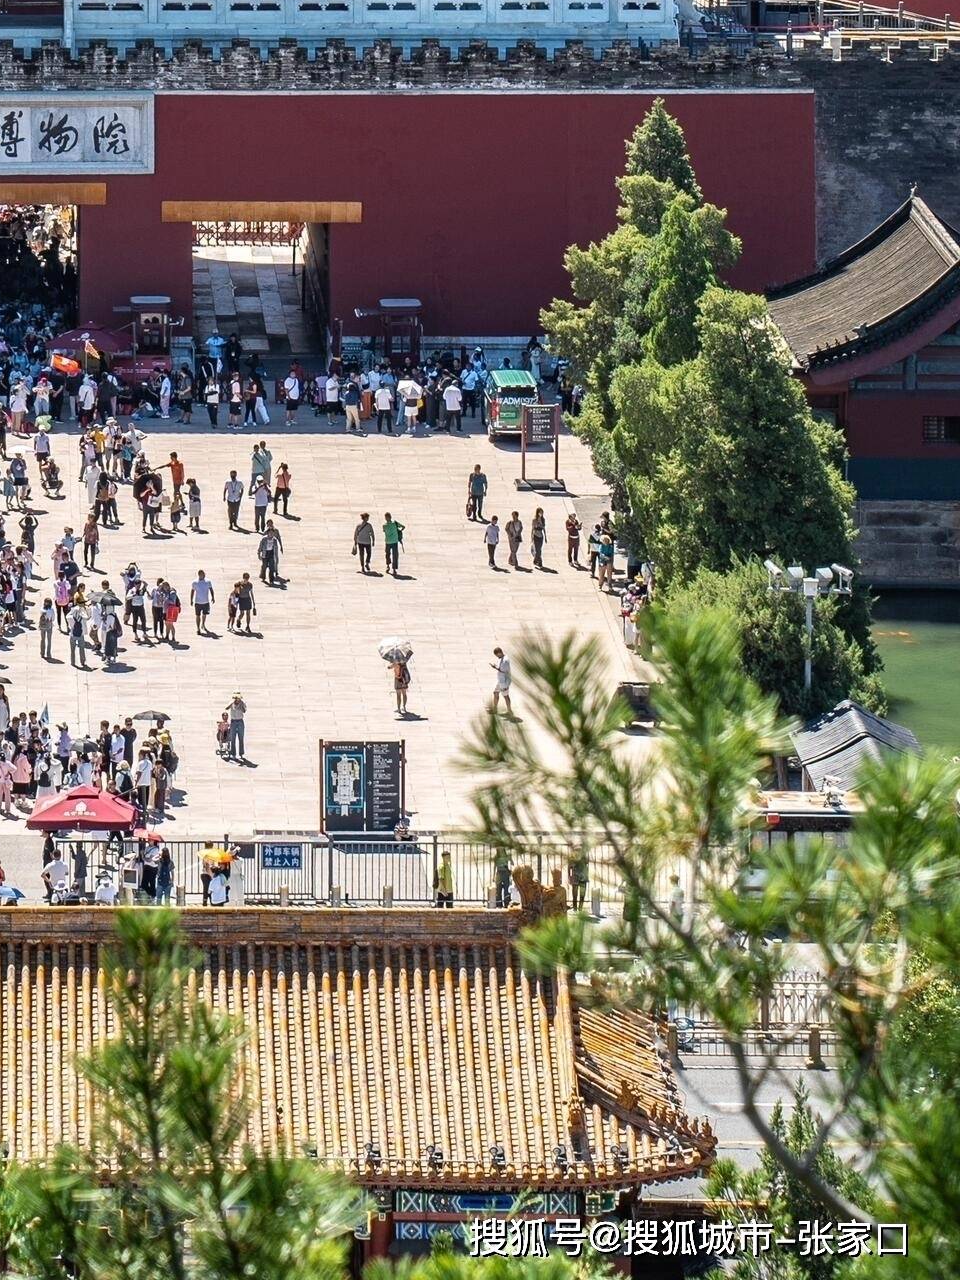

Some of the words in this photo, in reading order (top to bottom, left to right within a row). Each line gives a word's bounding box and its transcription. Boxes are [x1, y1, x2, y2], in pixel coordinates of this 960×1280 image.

[264, 846, 300, 857] 外部车辆
[264, 857, 300, 867] 禁止入内
